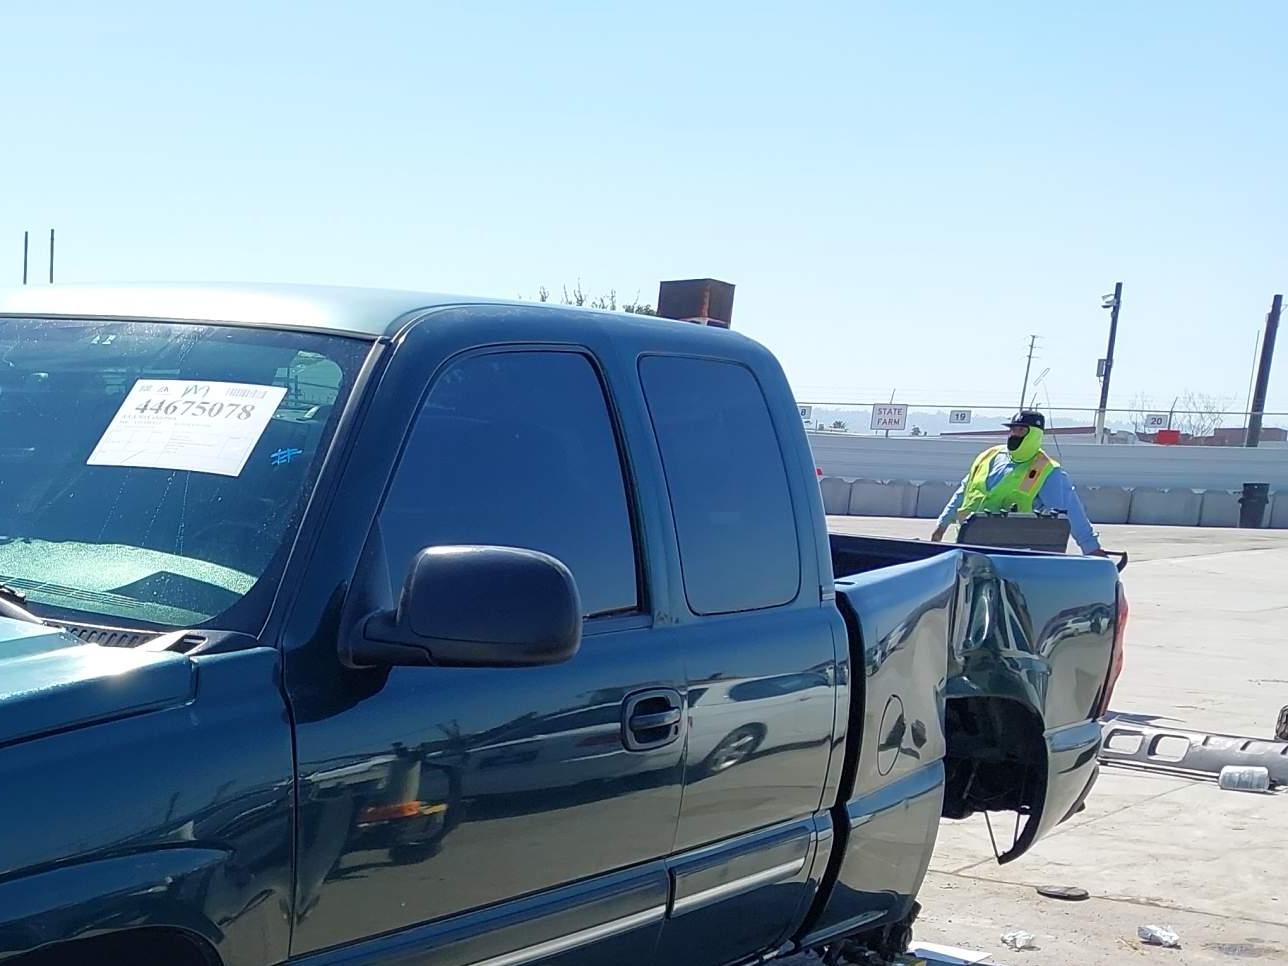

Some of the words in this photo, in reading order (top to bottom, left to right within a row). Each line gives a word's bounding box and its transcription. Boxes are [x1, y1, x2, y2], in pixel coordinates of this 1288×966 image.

[135, 399, 256, 420] 44675078
[877, 407, 902, 415] STATE
[955, 413, 966, 421] 19
[1151, 417, 1162, 425] 20
